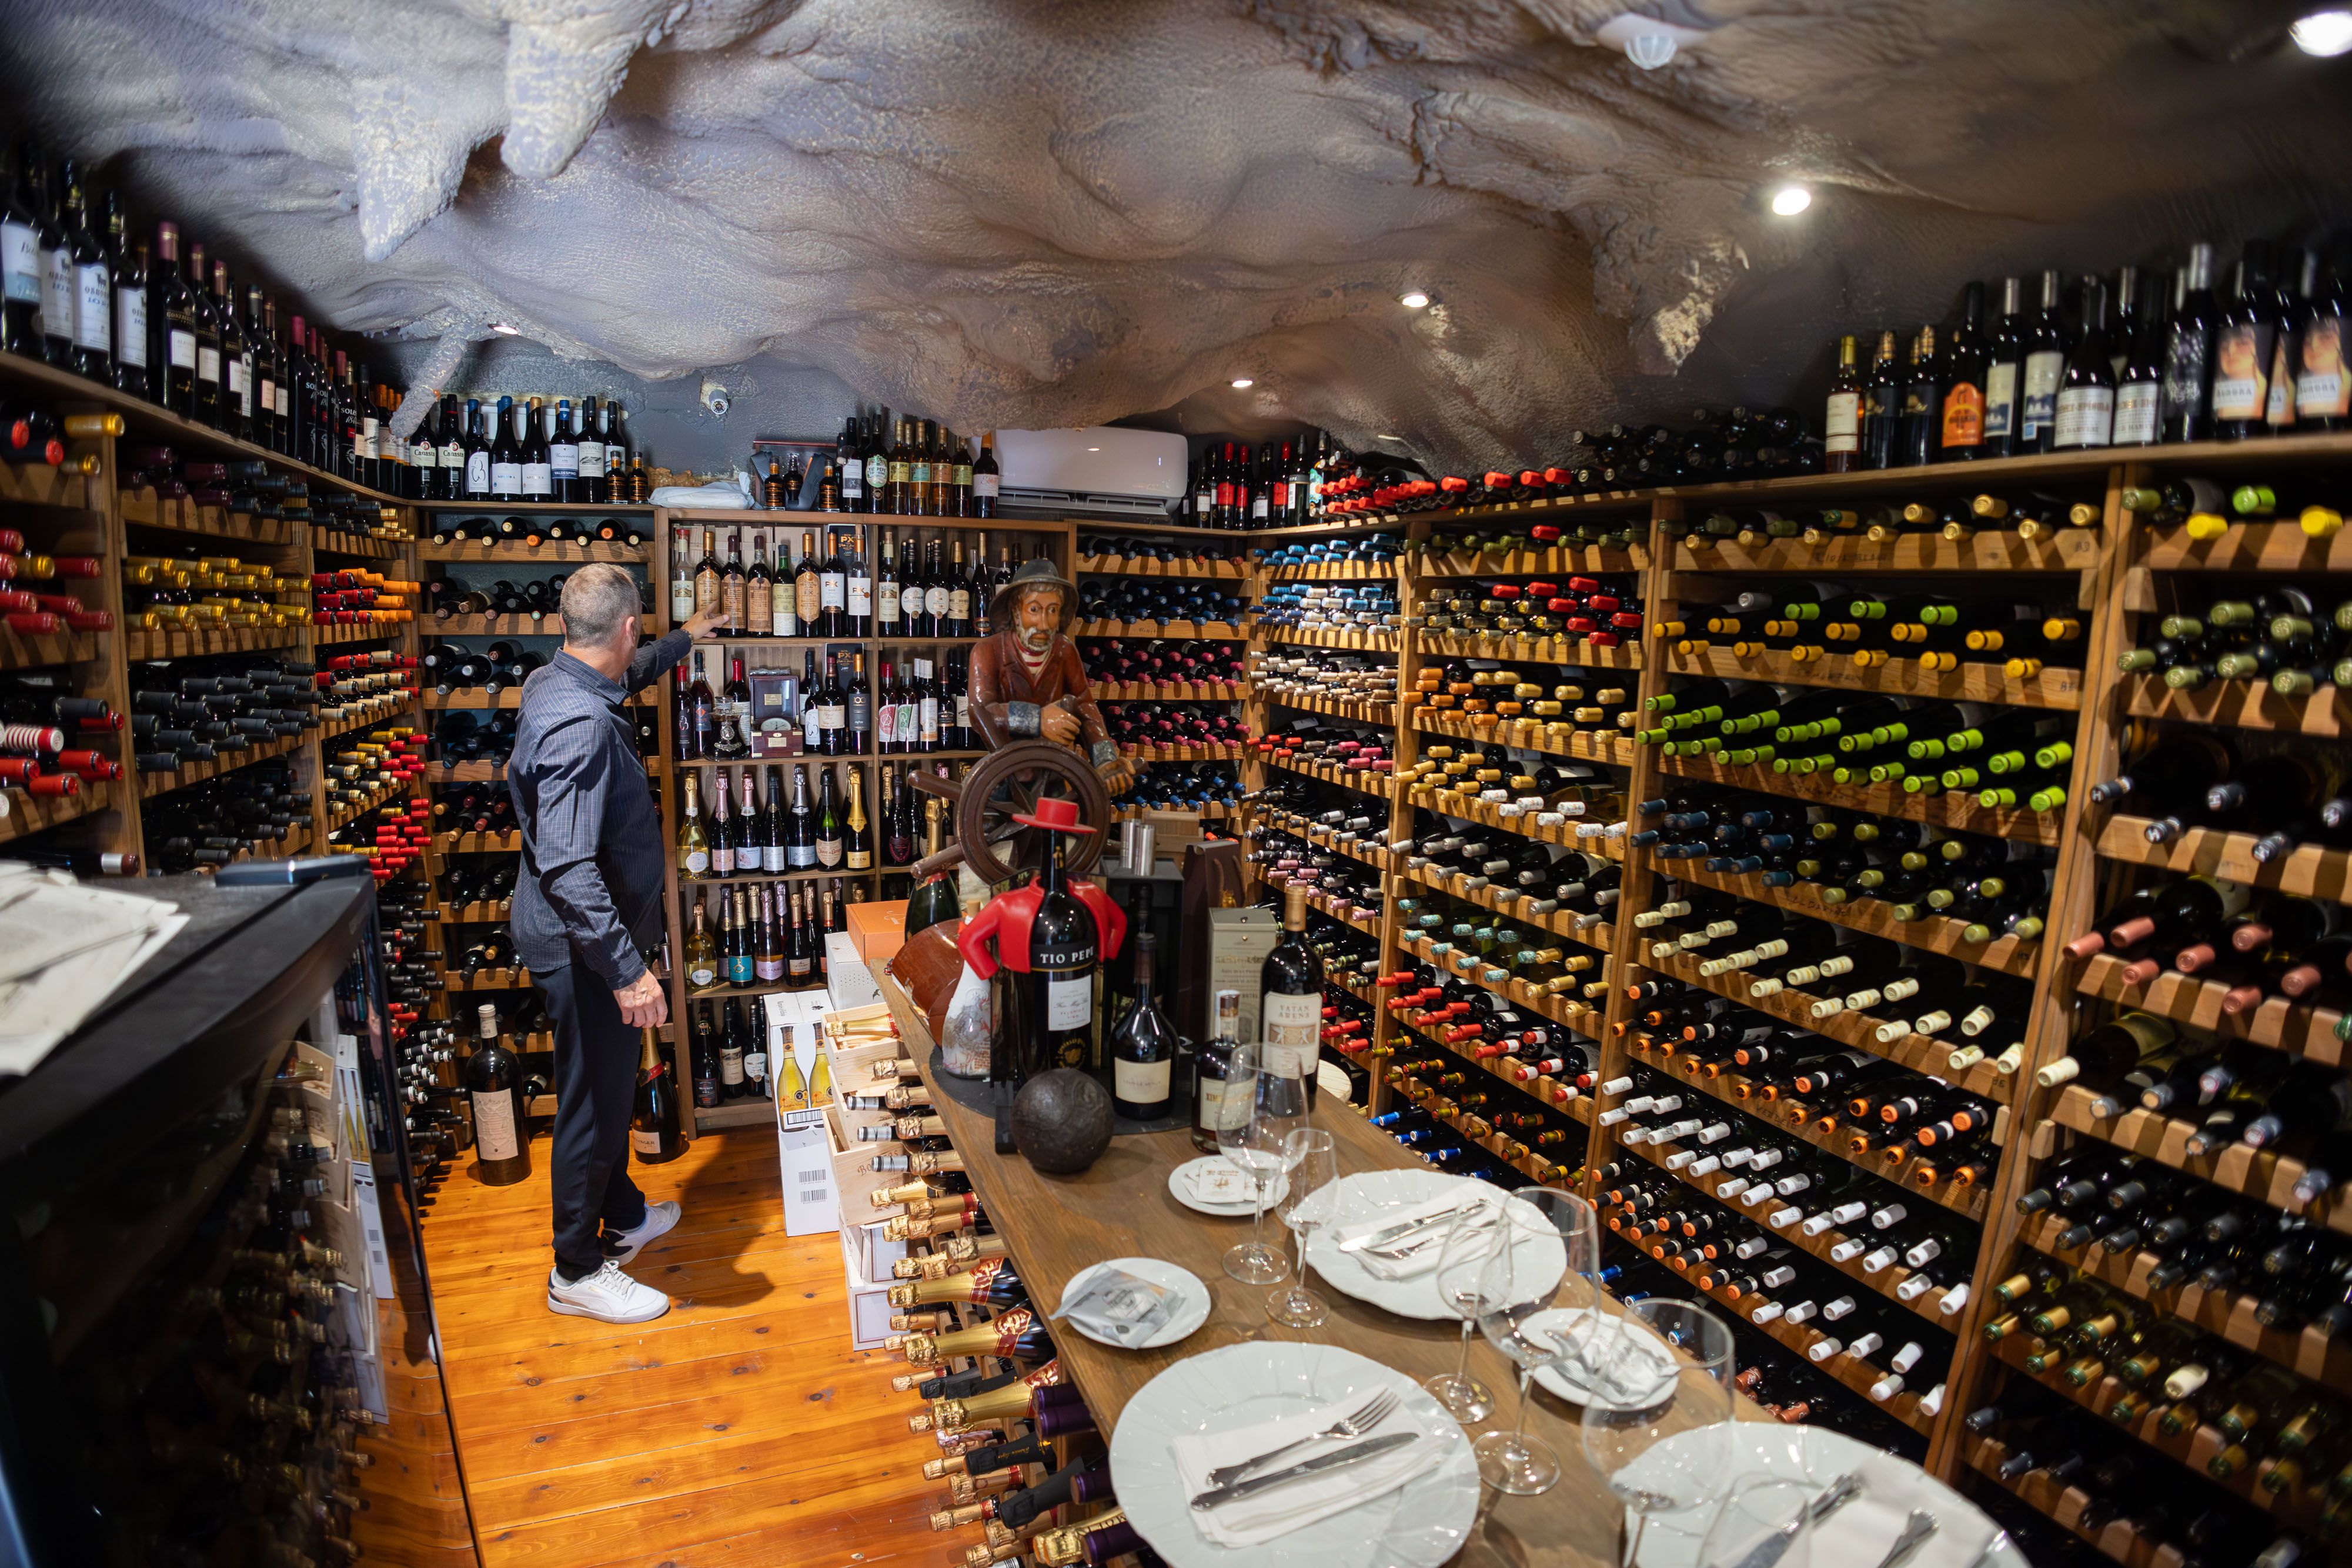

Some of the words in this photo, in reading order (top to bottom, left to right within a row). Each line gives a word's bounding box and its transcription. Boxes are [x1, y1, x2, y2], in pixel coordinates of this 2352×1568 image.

[414, 449, 435, 457] Canasta
[1040, 953, 1065, 964] TIO
[1071, 945, 1094, 962] PEPE
